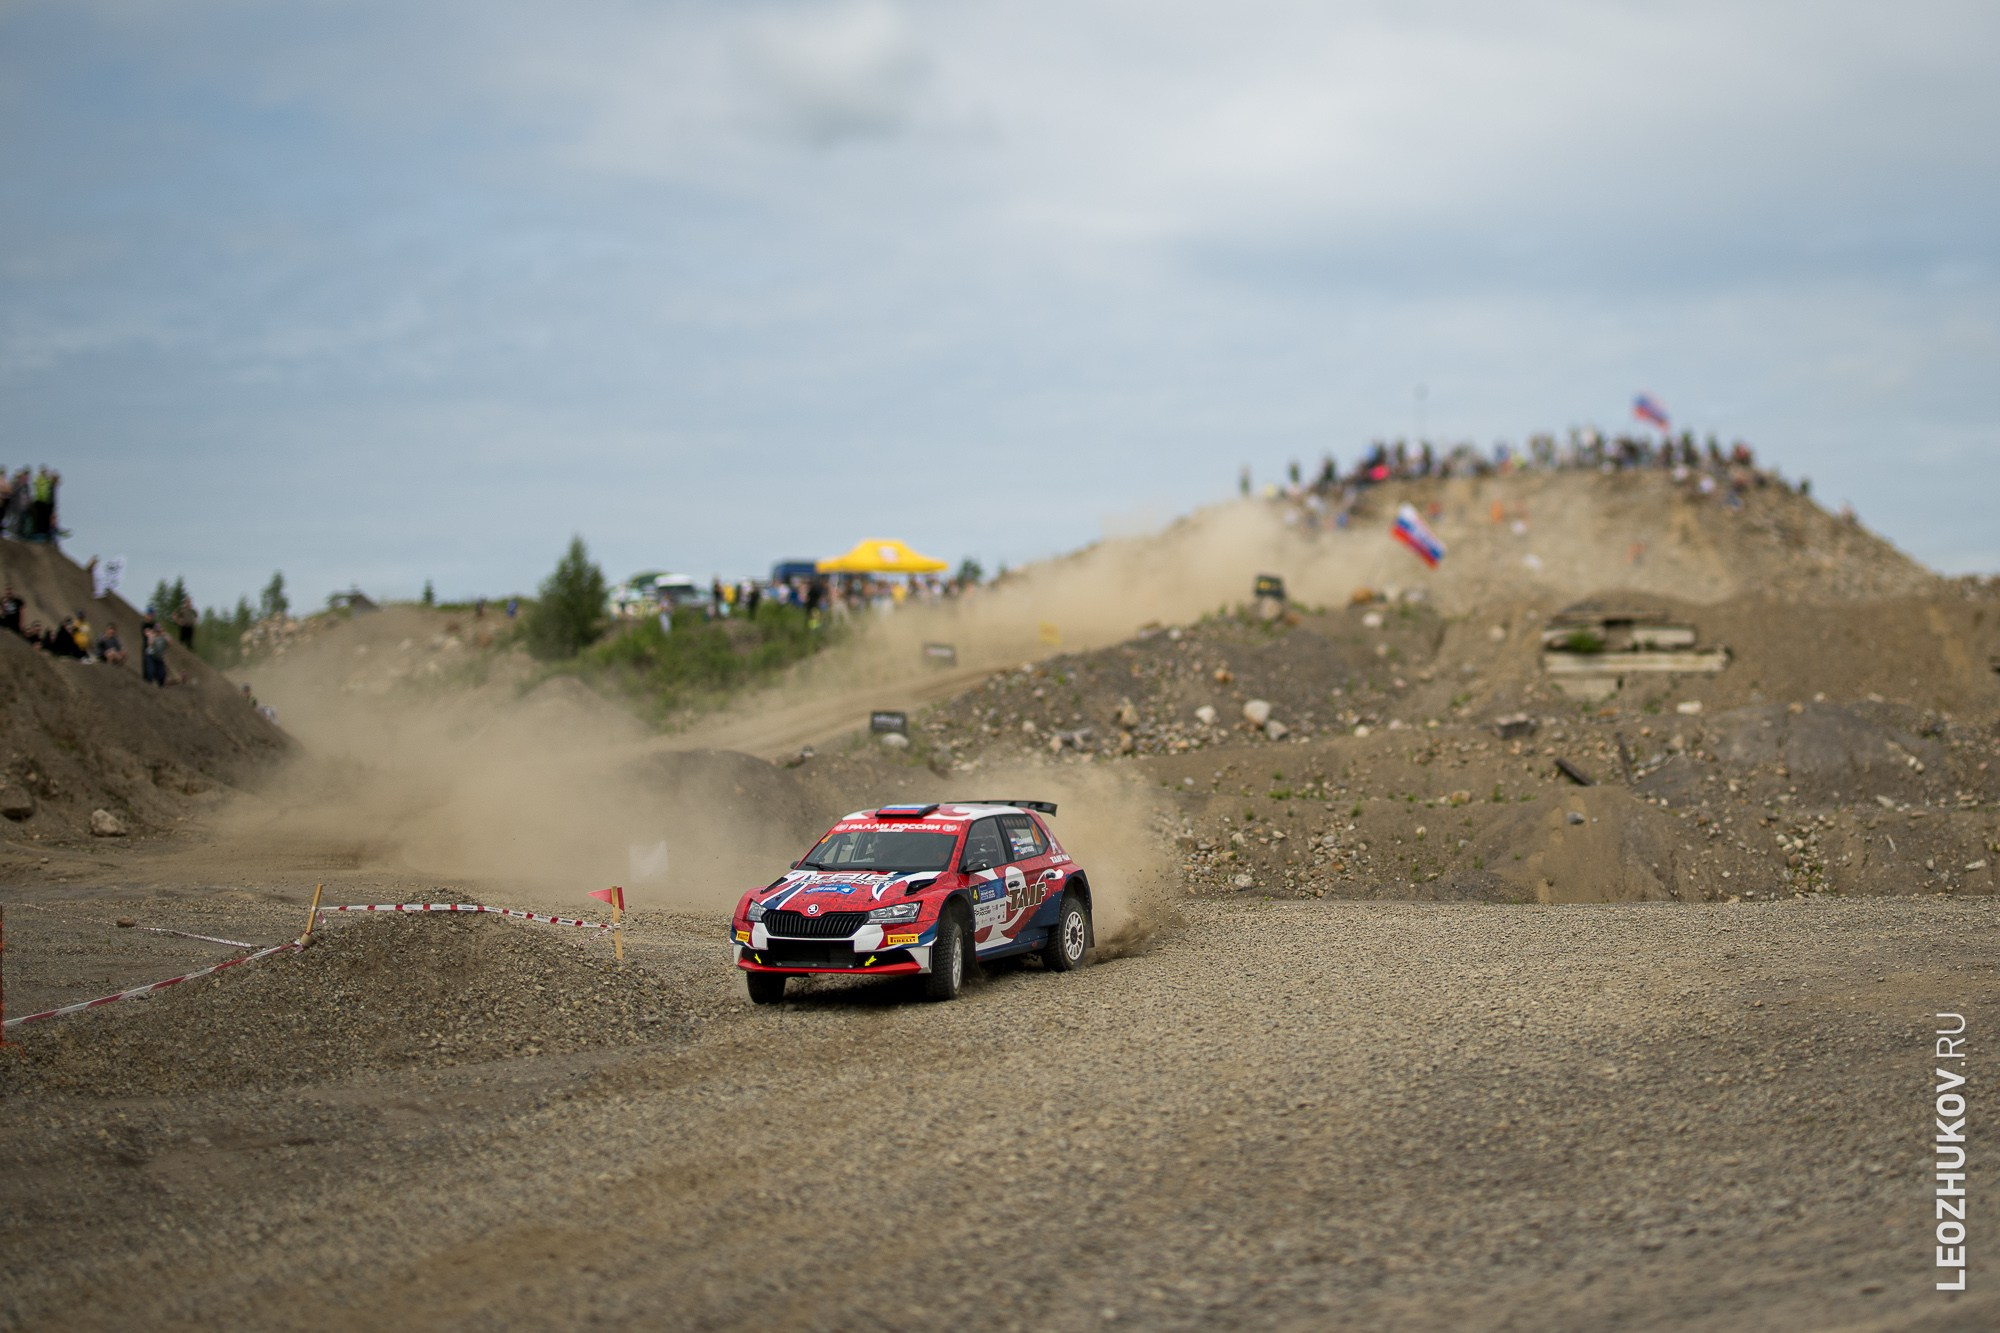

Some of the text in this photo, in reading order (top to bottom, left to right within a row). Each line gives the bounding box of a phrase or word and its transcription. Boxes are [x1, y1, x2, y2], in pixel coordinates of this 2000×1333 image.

[890, 823, 940, 831] РОССИИ
[972, 889, 979, 901] 4
[1009, 882, 1046, 912] TAIF
